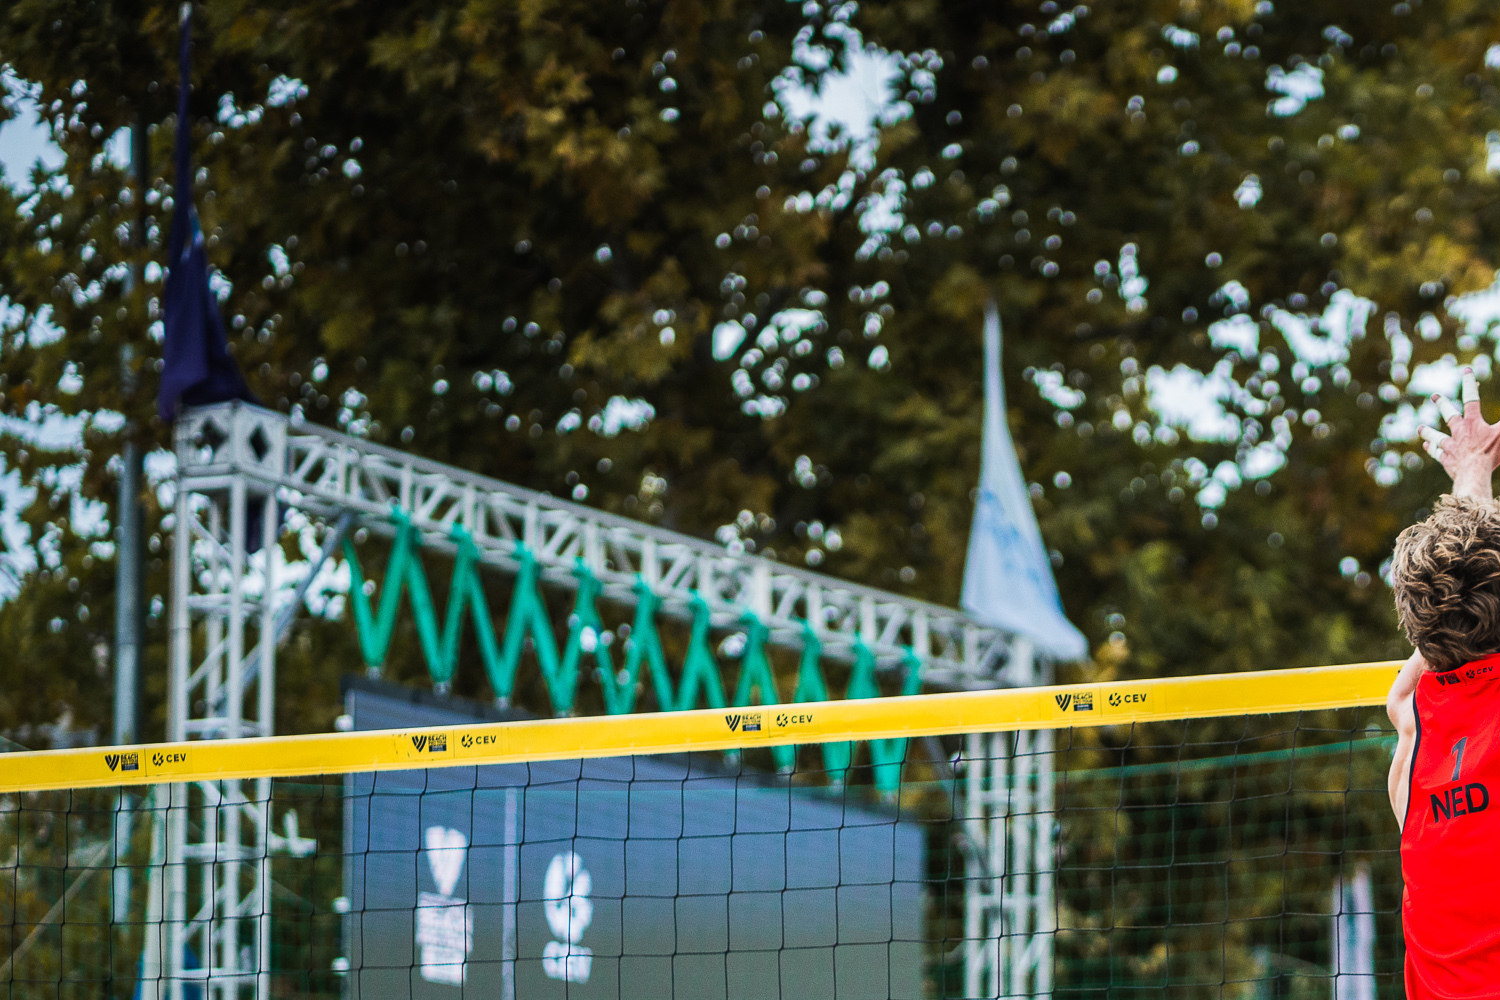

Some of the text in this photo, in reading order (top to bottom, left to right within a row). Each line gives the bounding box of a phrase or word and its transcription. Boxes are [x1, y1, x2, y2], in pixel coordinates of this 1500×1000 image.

[1477, 666, 1493, 674] CEV
[1124, 693, 1147, 704] CEV
[791, 714, 813, 724] CEV
[475, 735, 497, 744] CEV
[166, 753, 187, 763] CEV
[1451, 736, 1468, 781] 1
[1430, 782, 1489, 823] NED
